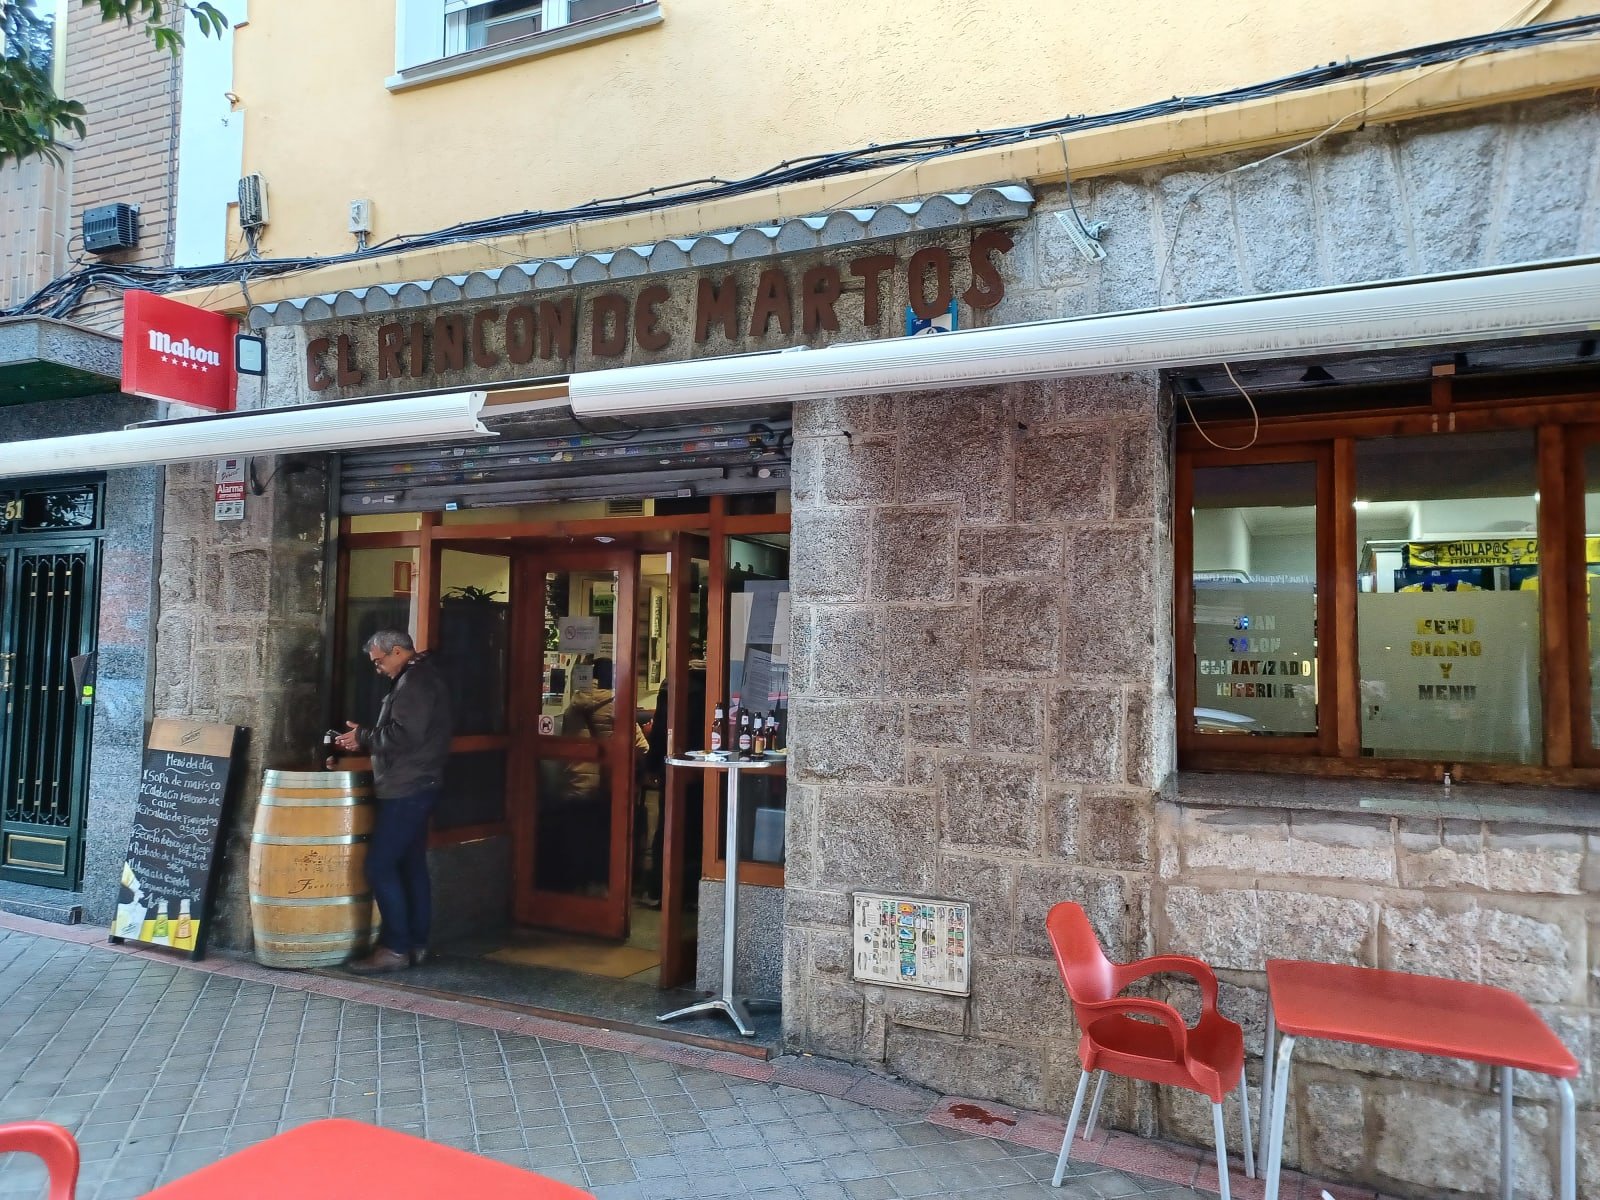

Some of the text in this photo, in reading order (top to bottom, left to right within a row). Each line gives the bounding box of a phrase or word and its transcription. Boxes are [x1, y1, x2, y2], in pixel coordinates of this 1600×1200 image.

[307, 230, 1014, 391] EL RINCON DE MARTOS
[148, 329, 220, 366] Mahou
[217, 484, 244, 493] Alarma
[5, 500, 23, 520] 51
[1448, 542, 1509, 557] CHULAP@S
[1411, 641, 1482, 656] DIARIO
[1440, 663, 1452, 678] Y
[1418, 685, 1476, 700] MENU
[171, 774, 182, 786] de
